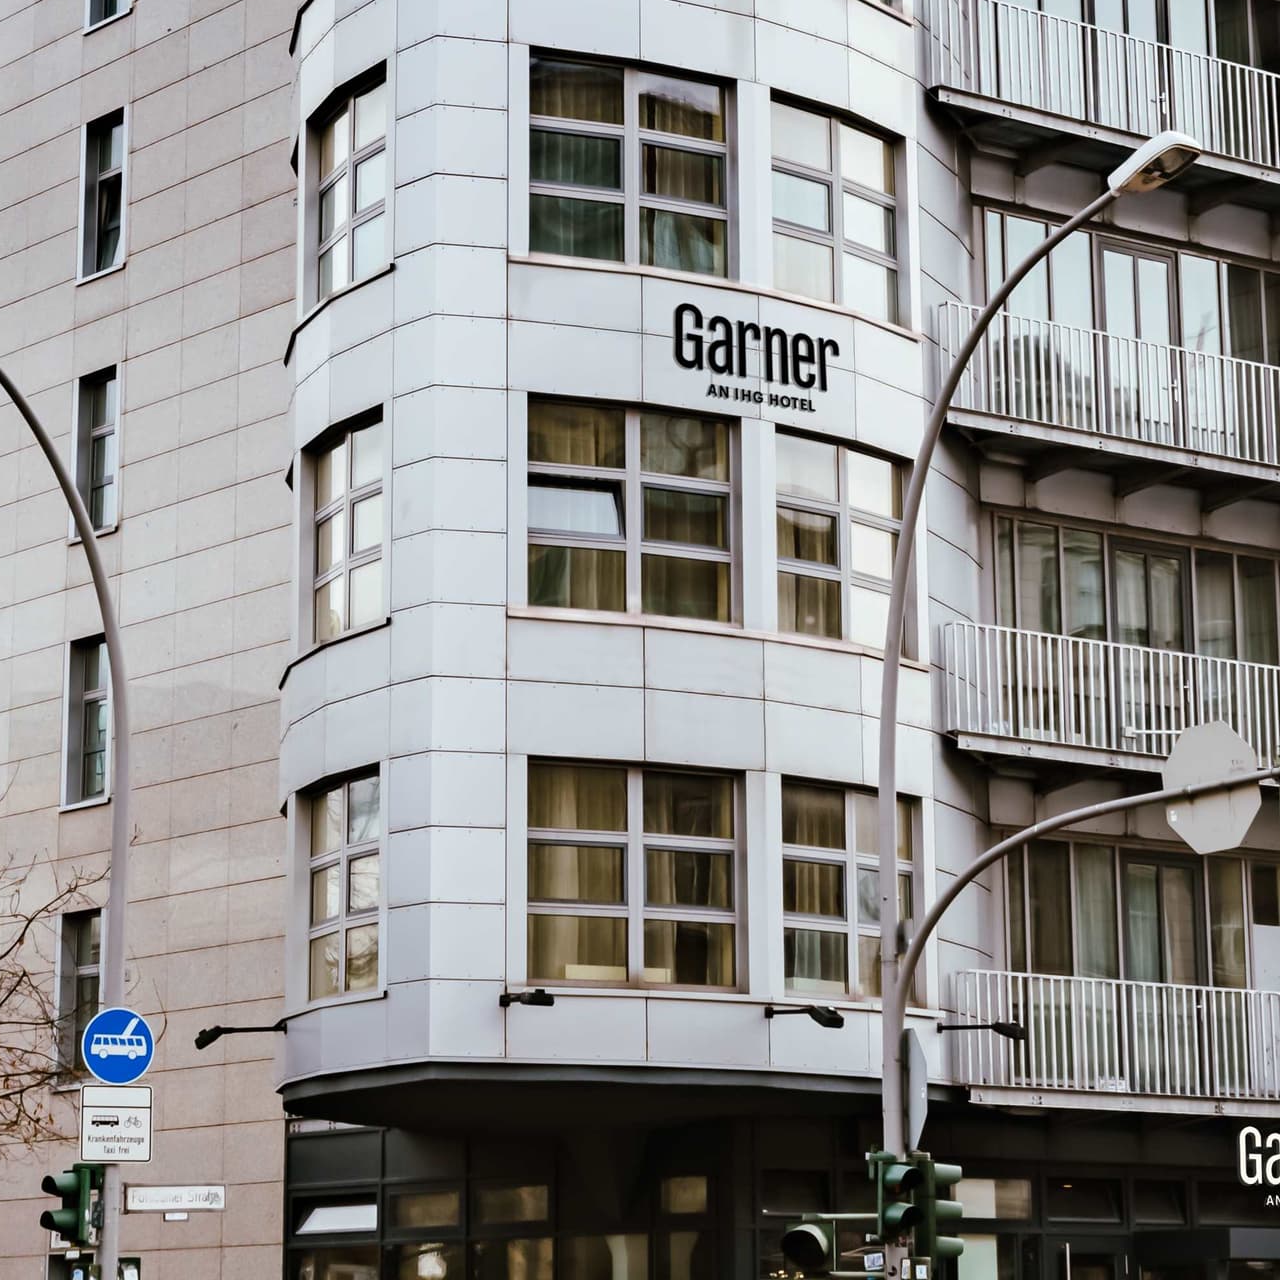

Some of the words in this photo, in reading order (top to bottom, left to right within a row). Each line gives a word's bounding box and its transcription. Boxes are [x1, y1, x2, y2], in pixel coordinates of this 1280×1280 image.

[673, 302, 840, 392] Garner
[706, 383, 730, 399] AN
[734, 387, 763, 404] IHG
[769, 393, 816, 412] HOTEL
[87, 1135, 145, 1145] Krankenfahrzeuge
[103, 1145, 116, 1154] Taxi
[118, 1145, 130, 1154] frei
